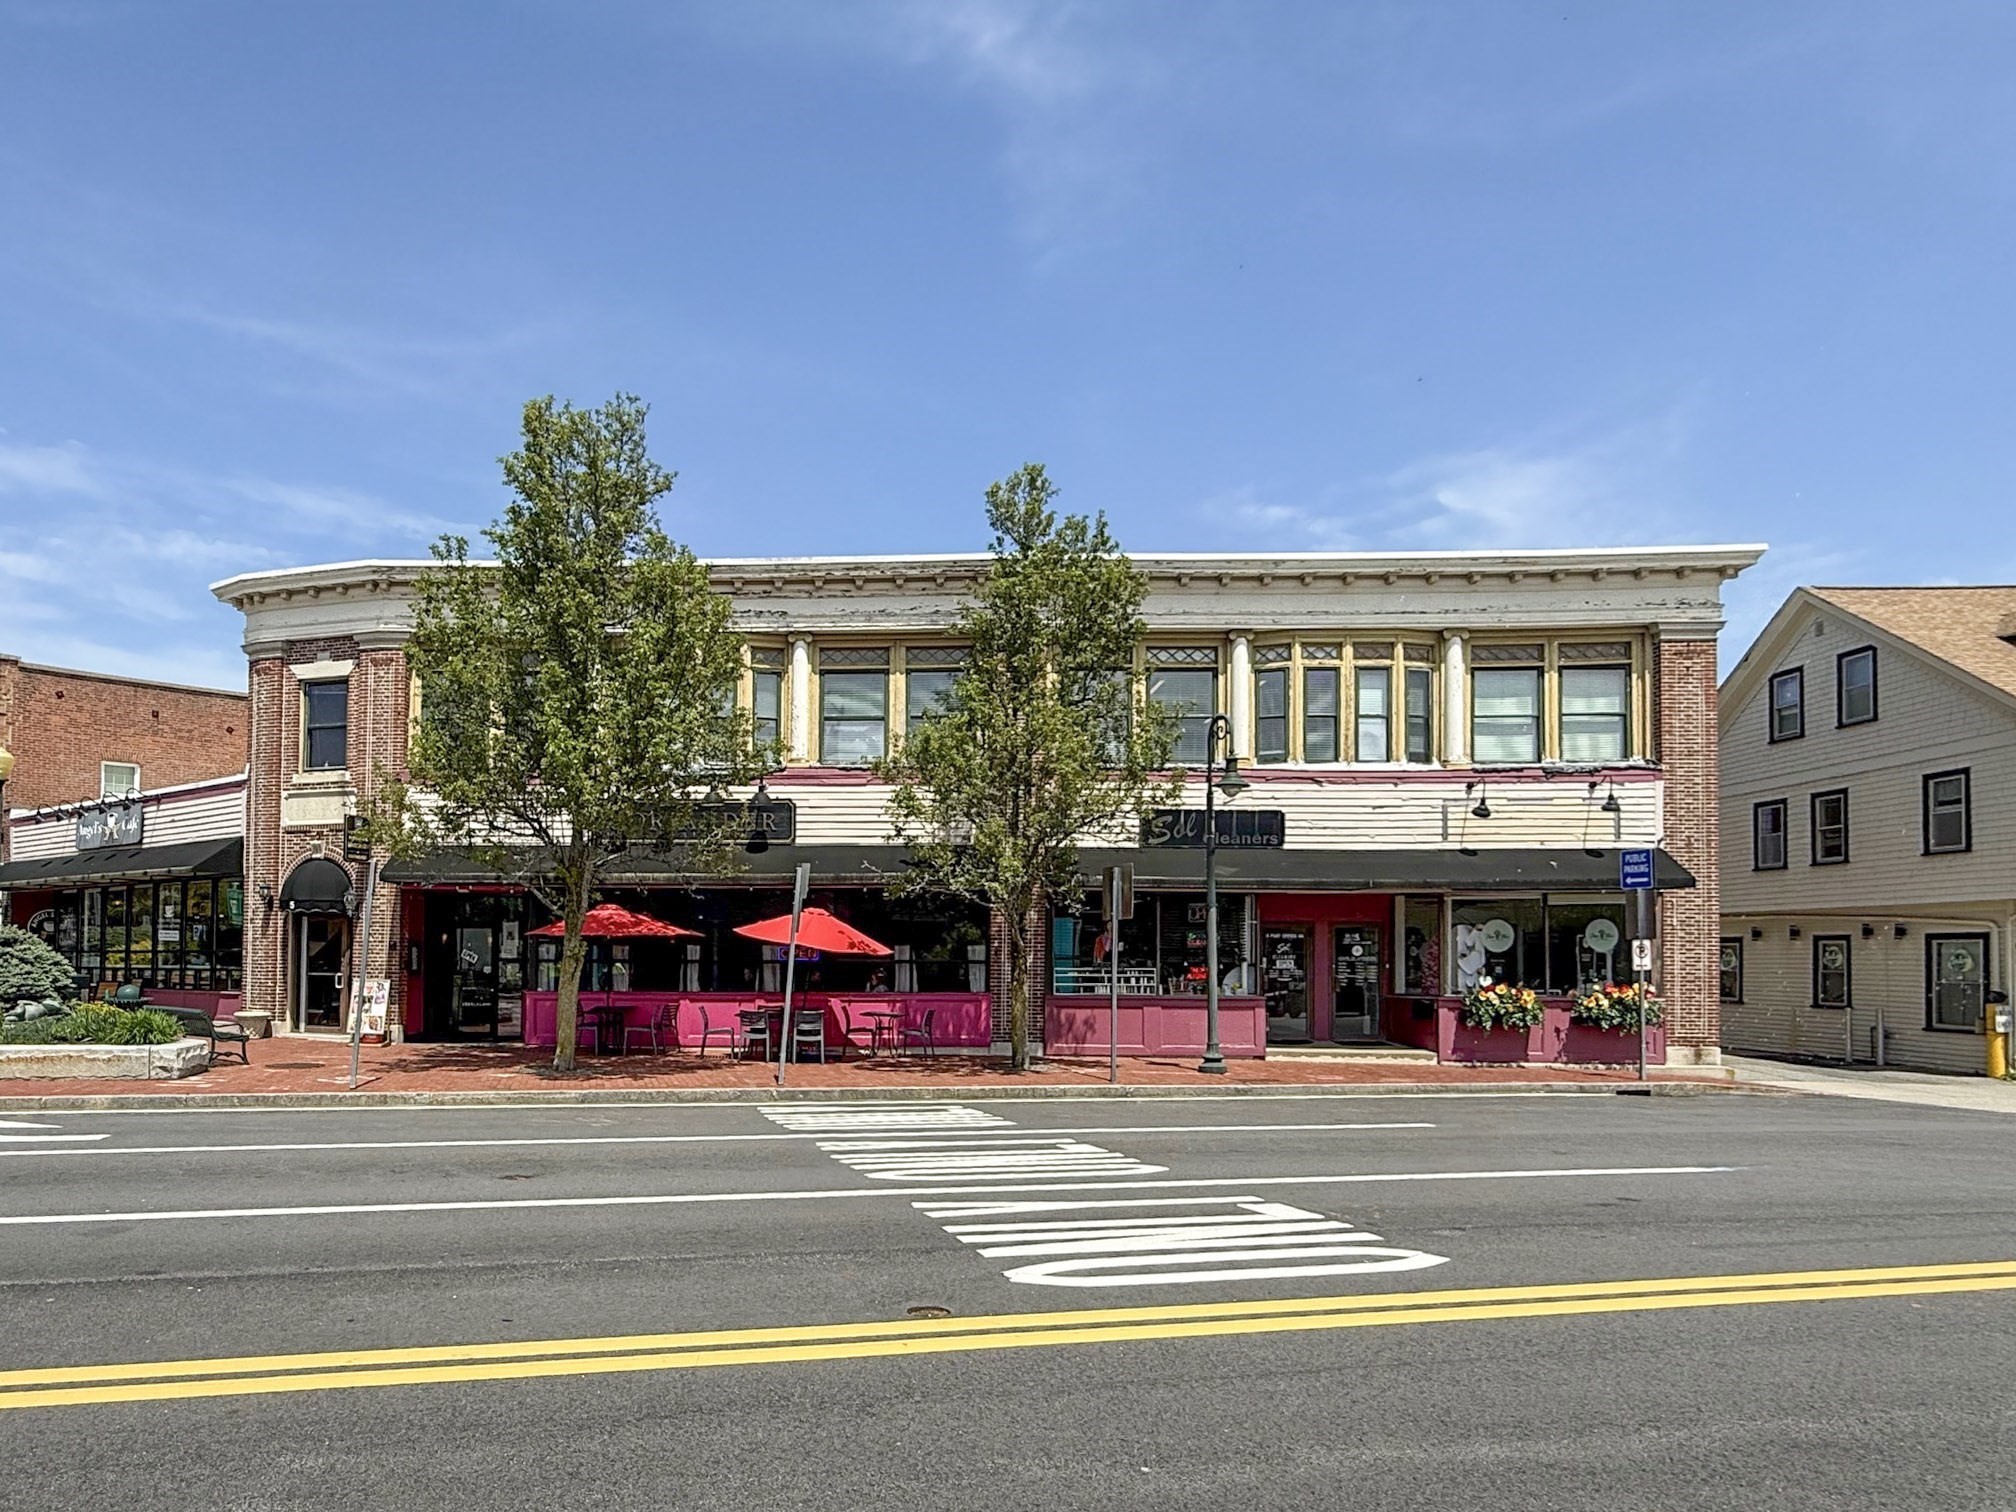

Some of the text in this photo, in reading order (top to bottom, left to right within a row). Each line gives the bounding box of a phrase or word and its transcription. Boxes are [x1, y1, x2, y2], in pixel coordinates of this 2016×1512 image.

[1624, 853, 1647, 863] PUBLIC
[1623, 863, 1649, 874] PARKING
[289, 900, 295, 910] 5
